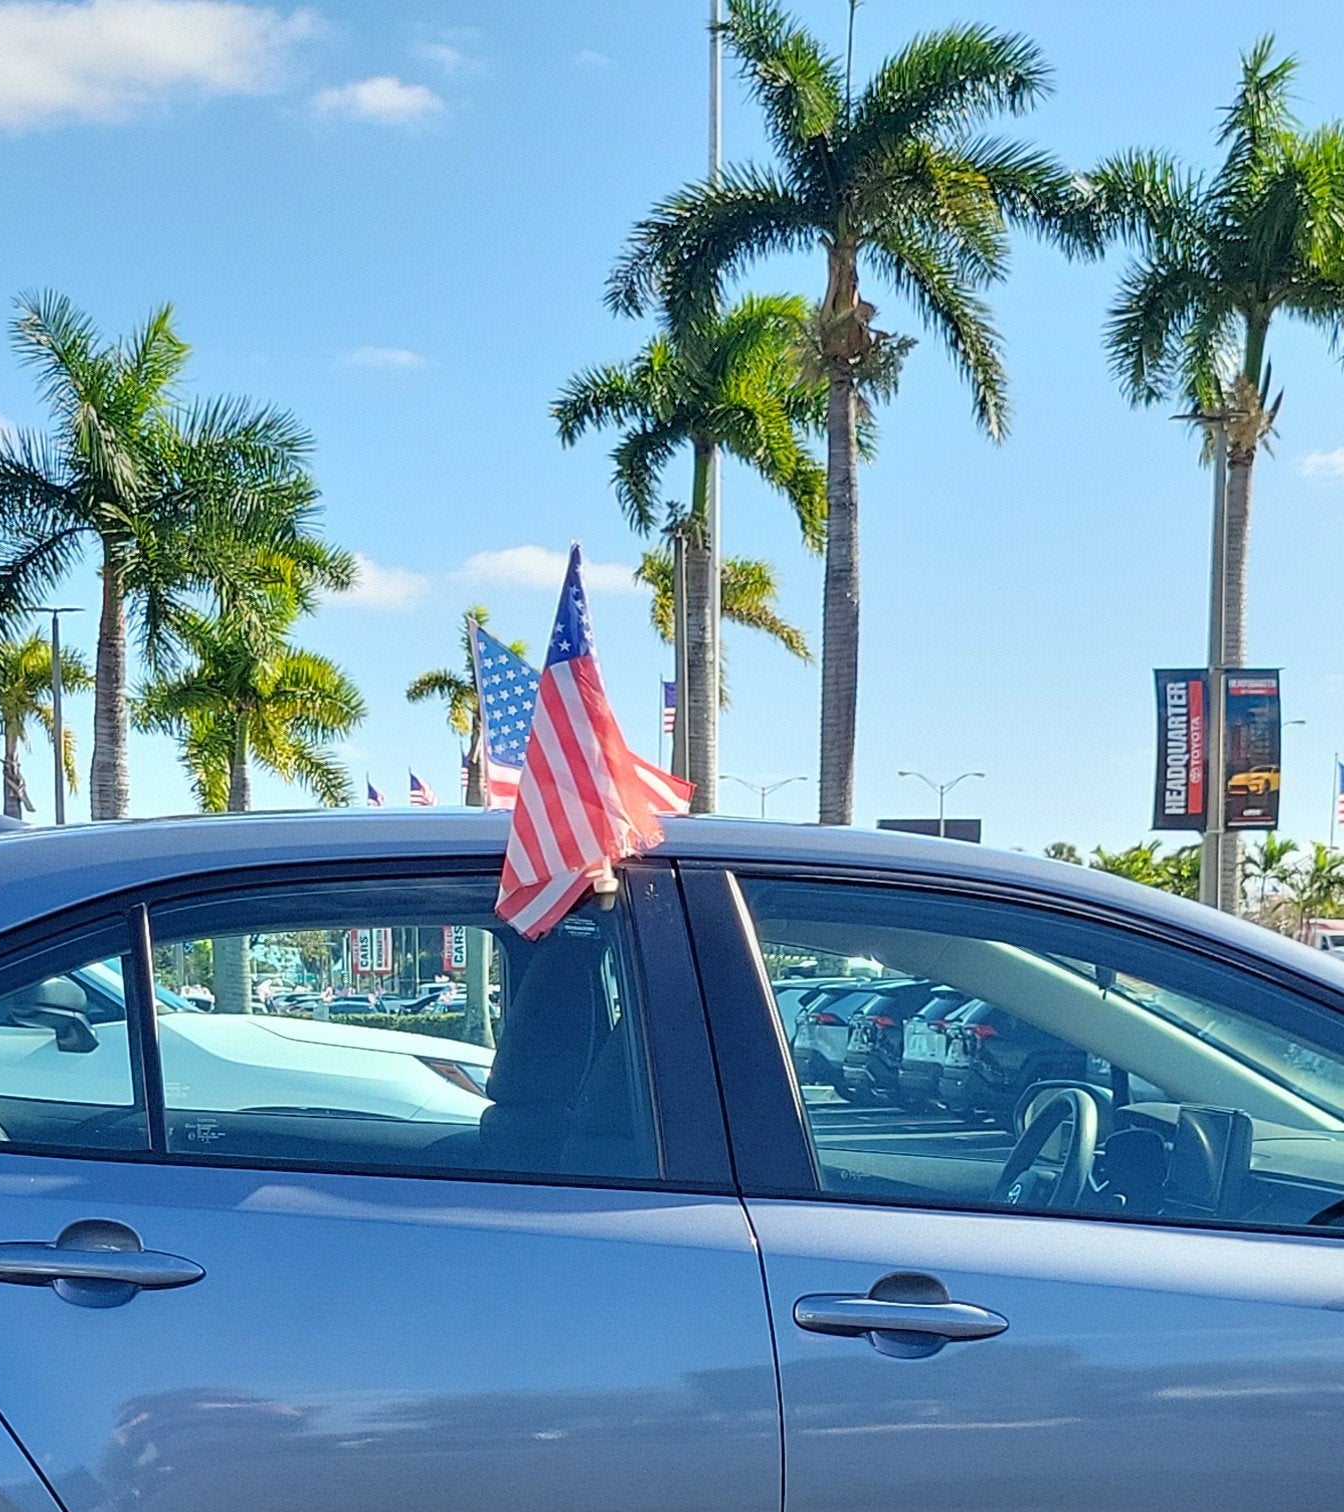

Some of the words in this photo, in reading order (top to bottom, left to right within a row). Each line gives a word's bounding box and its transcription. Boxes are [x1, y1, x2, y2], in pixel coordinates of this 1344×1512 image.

[1164, 681, 1188, 816] HEADQUARTER
[1190, 715, 1203, 769] TOYOTA
[360, 936, 369, 967] CARS
[454, 925, 464, 963] CARS
